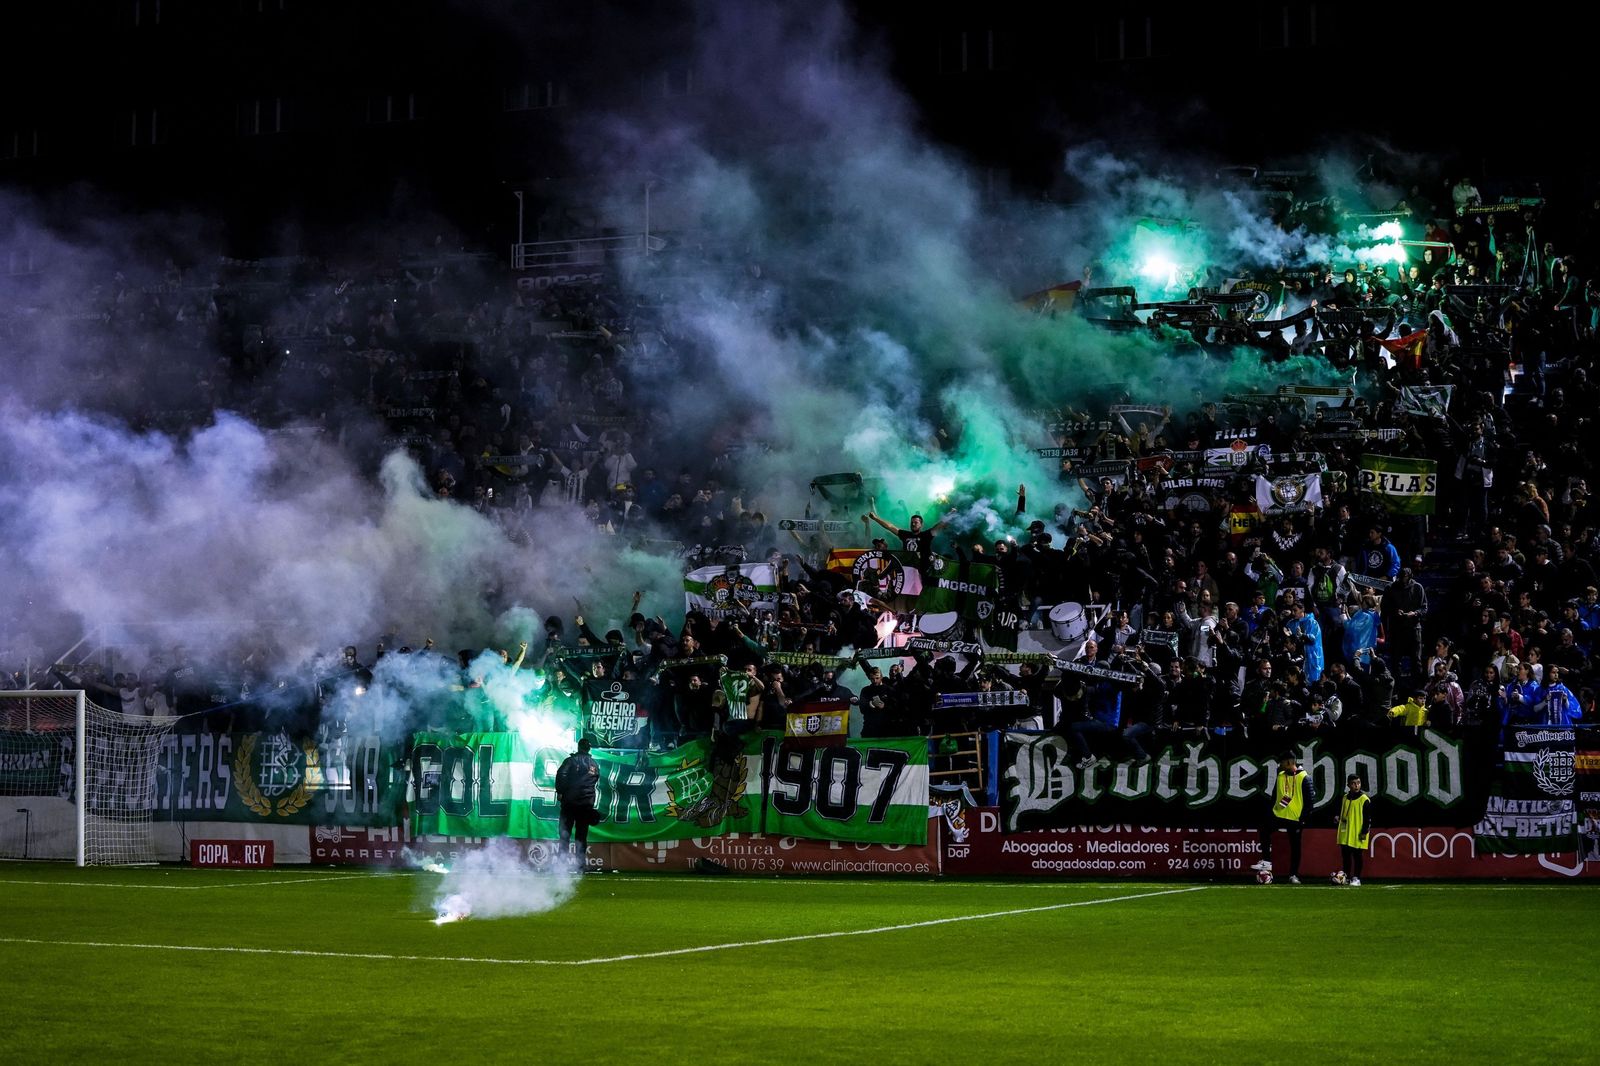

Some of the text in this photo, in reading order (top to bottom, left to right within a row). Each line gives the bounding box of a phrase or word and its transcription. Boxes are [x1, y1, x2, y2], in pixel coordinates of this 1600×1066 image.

[1161, 479, 1225, 490] PILAS FANS
[1360, 471, 1436, 492] PILAS
[938, 578, 987, 596] MORON
[998, 612, 1018, 629] UR
[731, 679, 748, 697] 12
[592, 701, 636, 716] OLIVEIRA
[590, 715, 635, 730] PRESENTE
[412, 743, 508, 817] GOL
[761, 736, 910, 824] 1907
[199, 844, 229, 864] COPA
[245, 844, 266, 864] REY
[709, 840, 774, 855] clínica
[947, 847, 971, 858] DaP
[1001, 840, 1073, 855] Abogados
[1086, 840, 1170, 853] Mediadores
[732, 858, 747, 870] 10
[751, 858, 766, 870] 75
[769, 858, 785, 870] 39
[791, 858, 930, 873] www.clinicadfranco.es
[1031, 858, 1241, 871] abogadosdap.com 924 695 110
